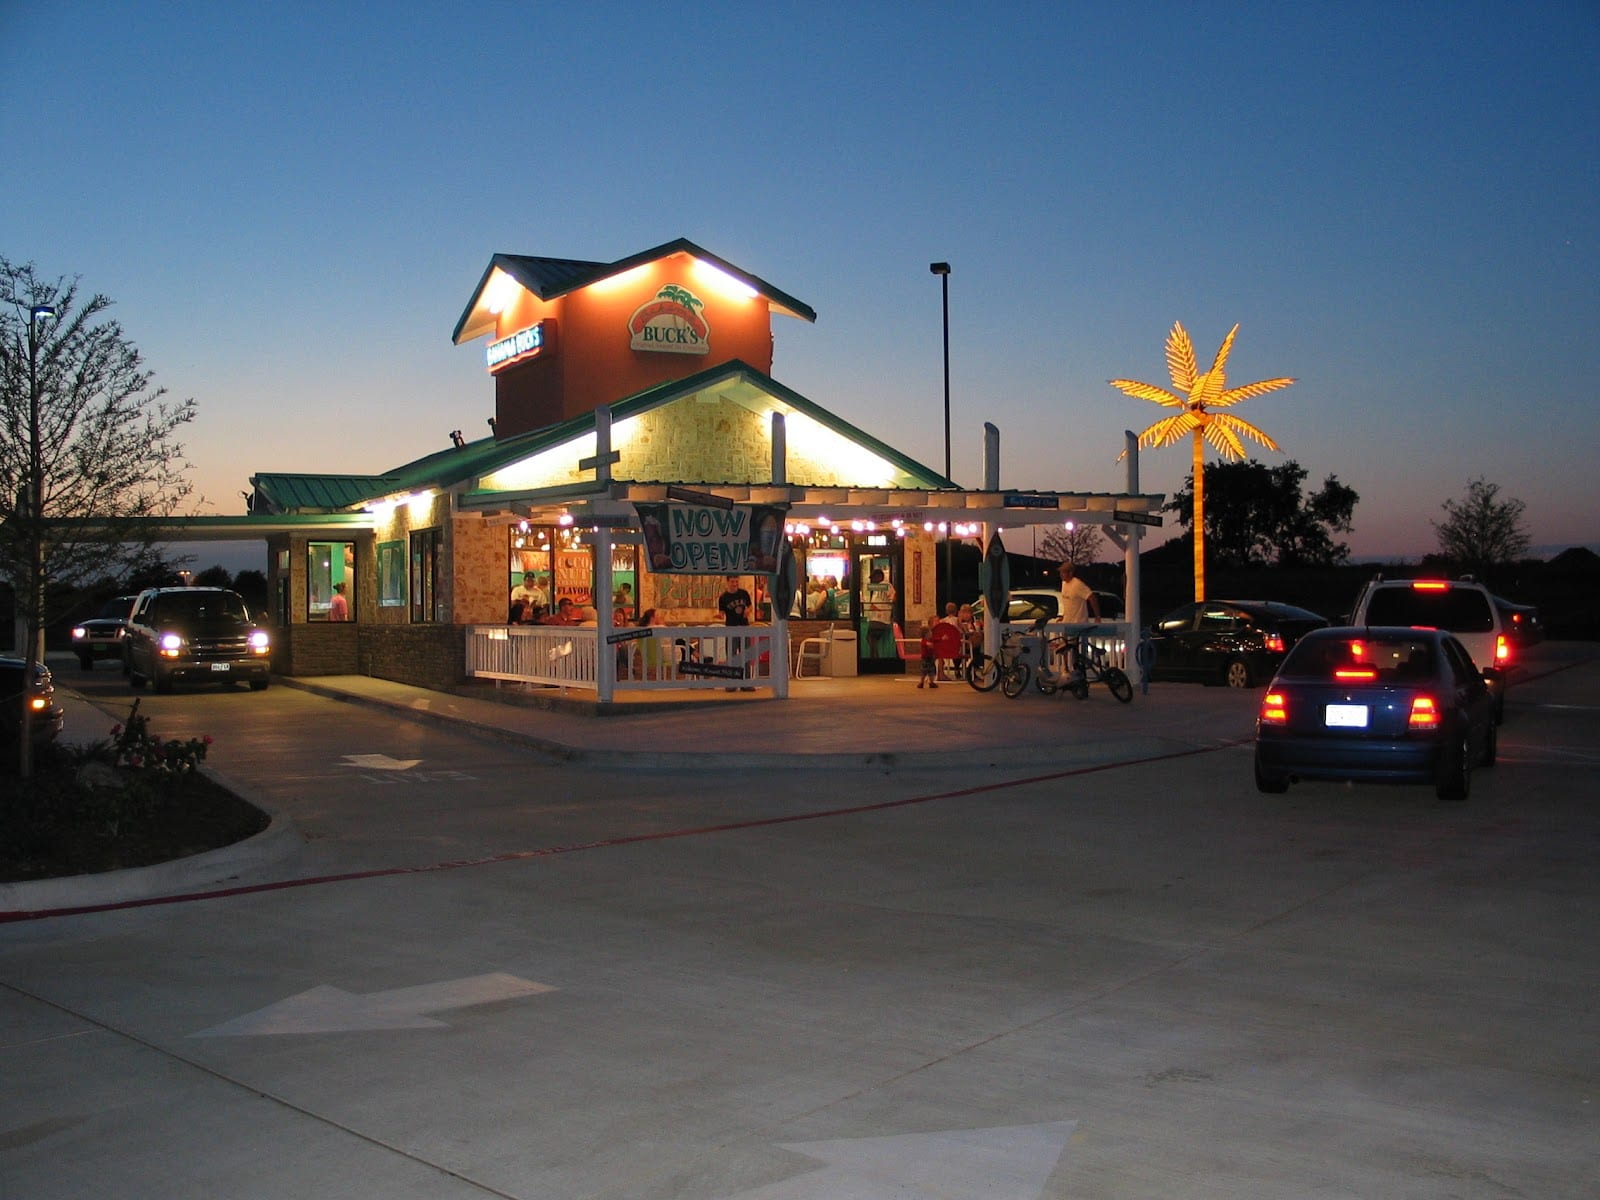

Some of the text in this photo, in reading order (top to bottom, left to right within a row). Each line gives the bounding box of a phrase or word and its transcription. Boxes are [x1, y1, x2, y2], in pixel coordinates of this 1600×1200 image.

[643, 325, 699, 345] BUCK'S
[672, 508, 746, 538] NOW
[670, 541, 750, 571] OPEN!
[557, 568, 590, 580] NUT
[557, 587, 590, 596] FLAVOR
